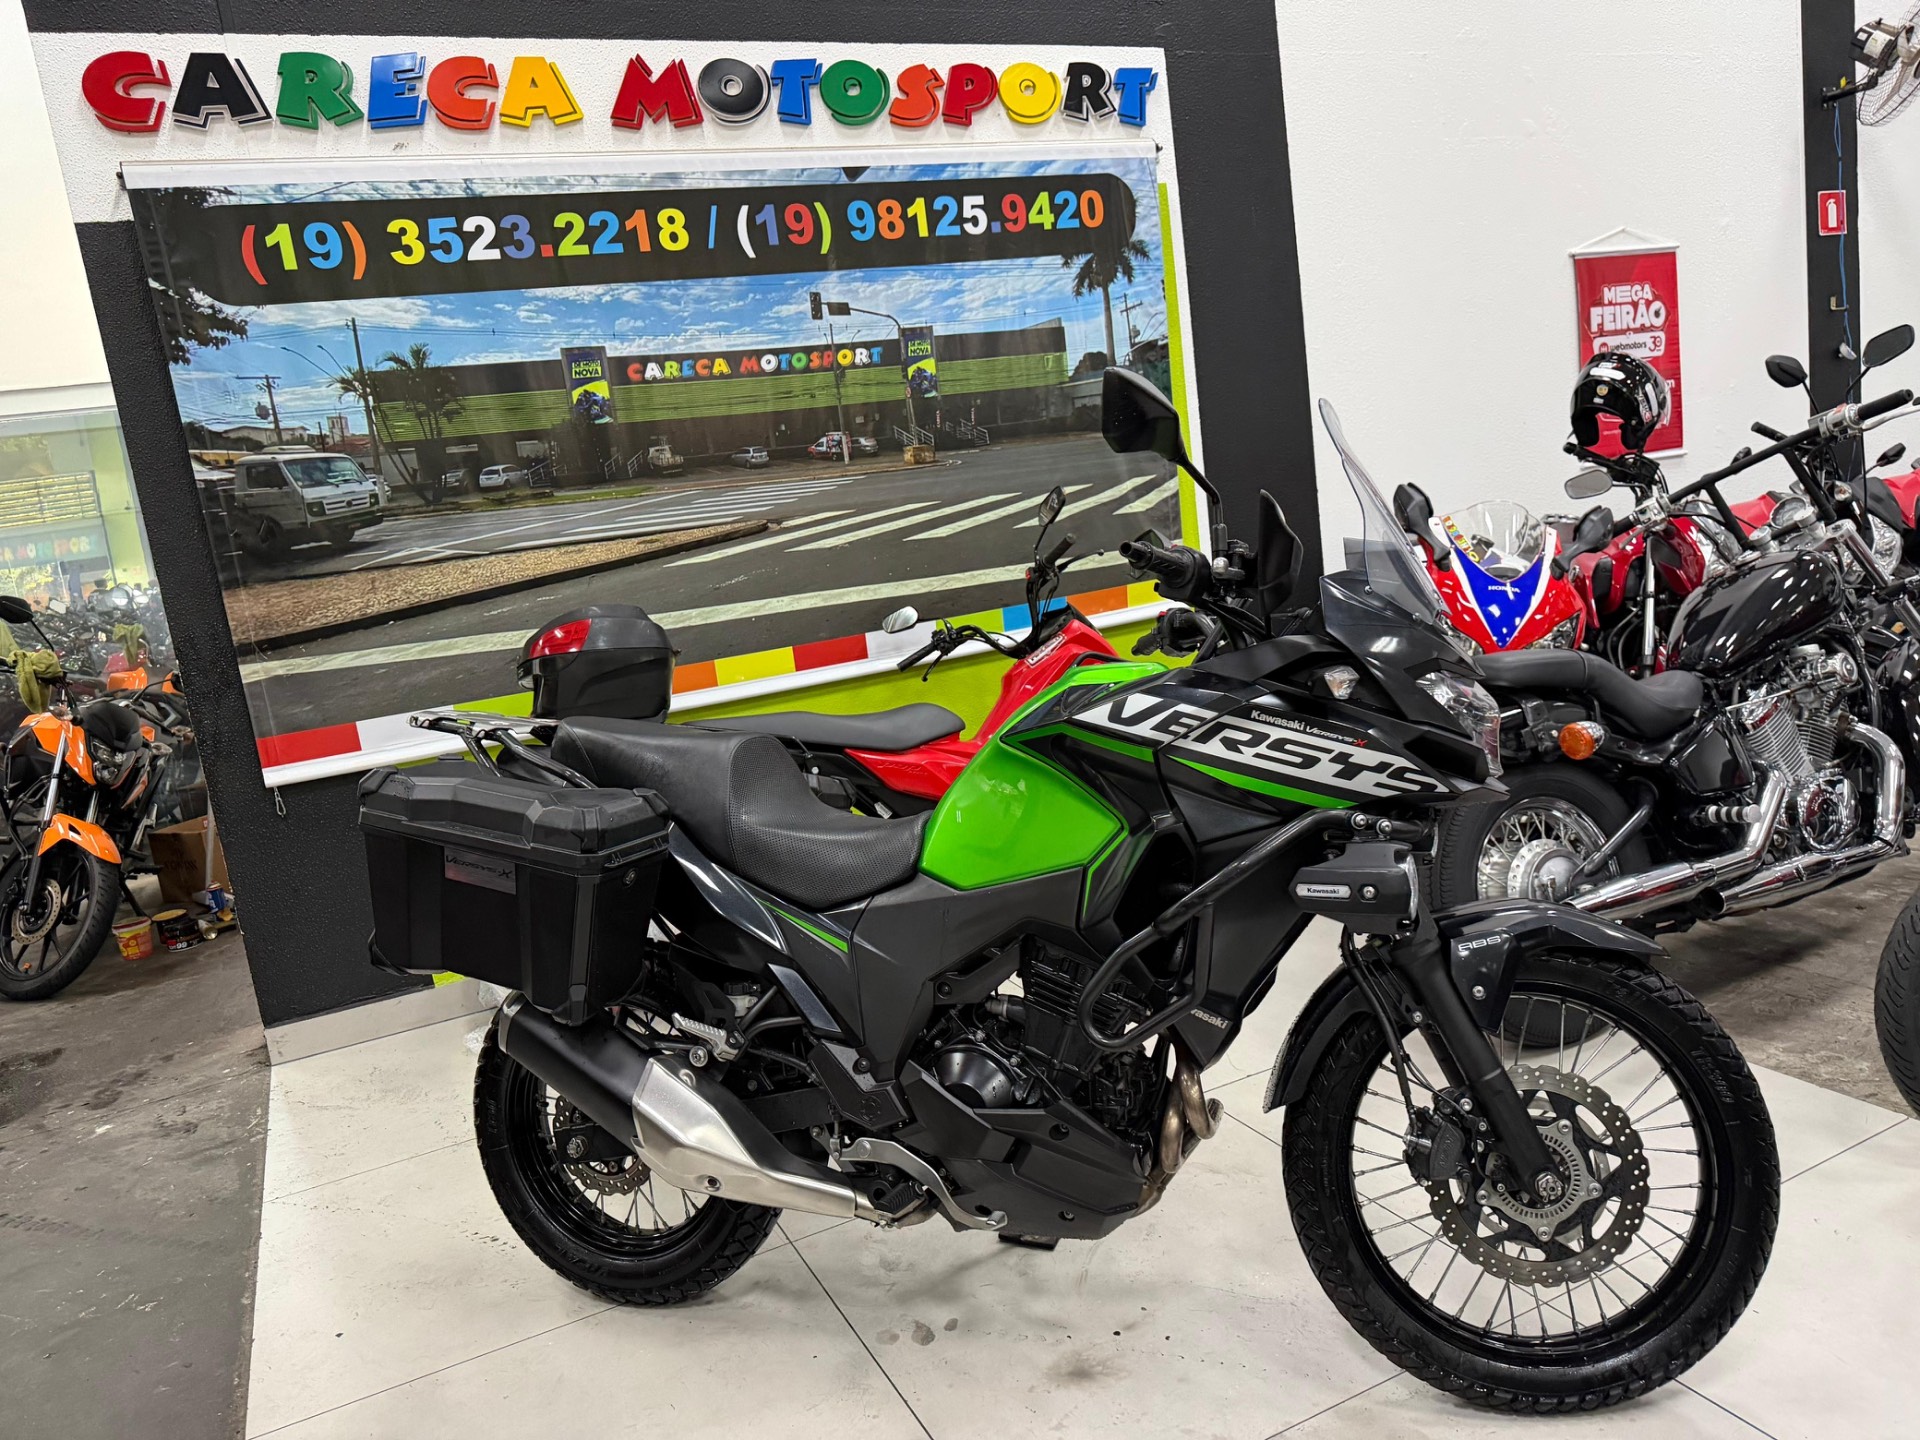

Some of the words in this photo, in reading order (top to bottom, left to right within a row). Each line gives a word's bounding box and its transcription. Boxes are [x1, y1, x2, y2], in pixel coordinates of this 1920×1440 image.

[81, 51, 585, 132] CARECA
[610, 53, 1157, 130] MOTOSPORT
[241, 221, 367, 285] (19)
[386, 208, 689, 265] 3523.2218
[737, 201, 832, 259] (19)
[850, 189, 1105, 241] 98125.9420
[1603, 284, 1653, 305] MEGA
[1590, 299, 1667, 332] FEIRÃO
[910, 347, 929, 355] NOVA
[1609, 341, 1647, 352] webmotors
[574, 368, 600, 377] NOVA
[627, 358, 732, 382] CARECA
[740, 346, 884, 374] MOTOSPORT
[1250, 709, 1306, 732] Kawasaki
[1108, 696, 1439, 793] VERSYS
[1306, 887, 1340, 895] Kawasaki
[1458, 935, 1502, 952] ABS
